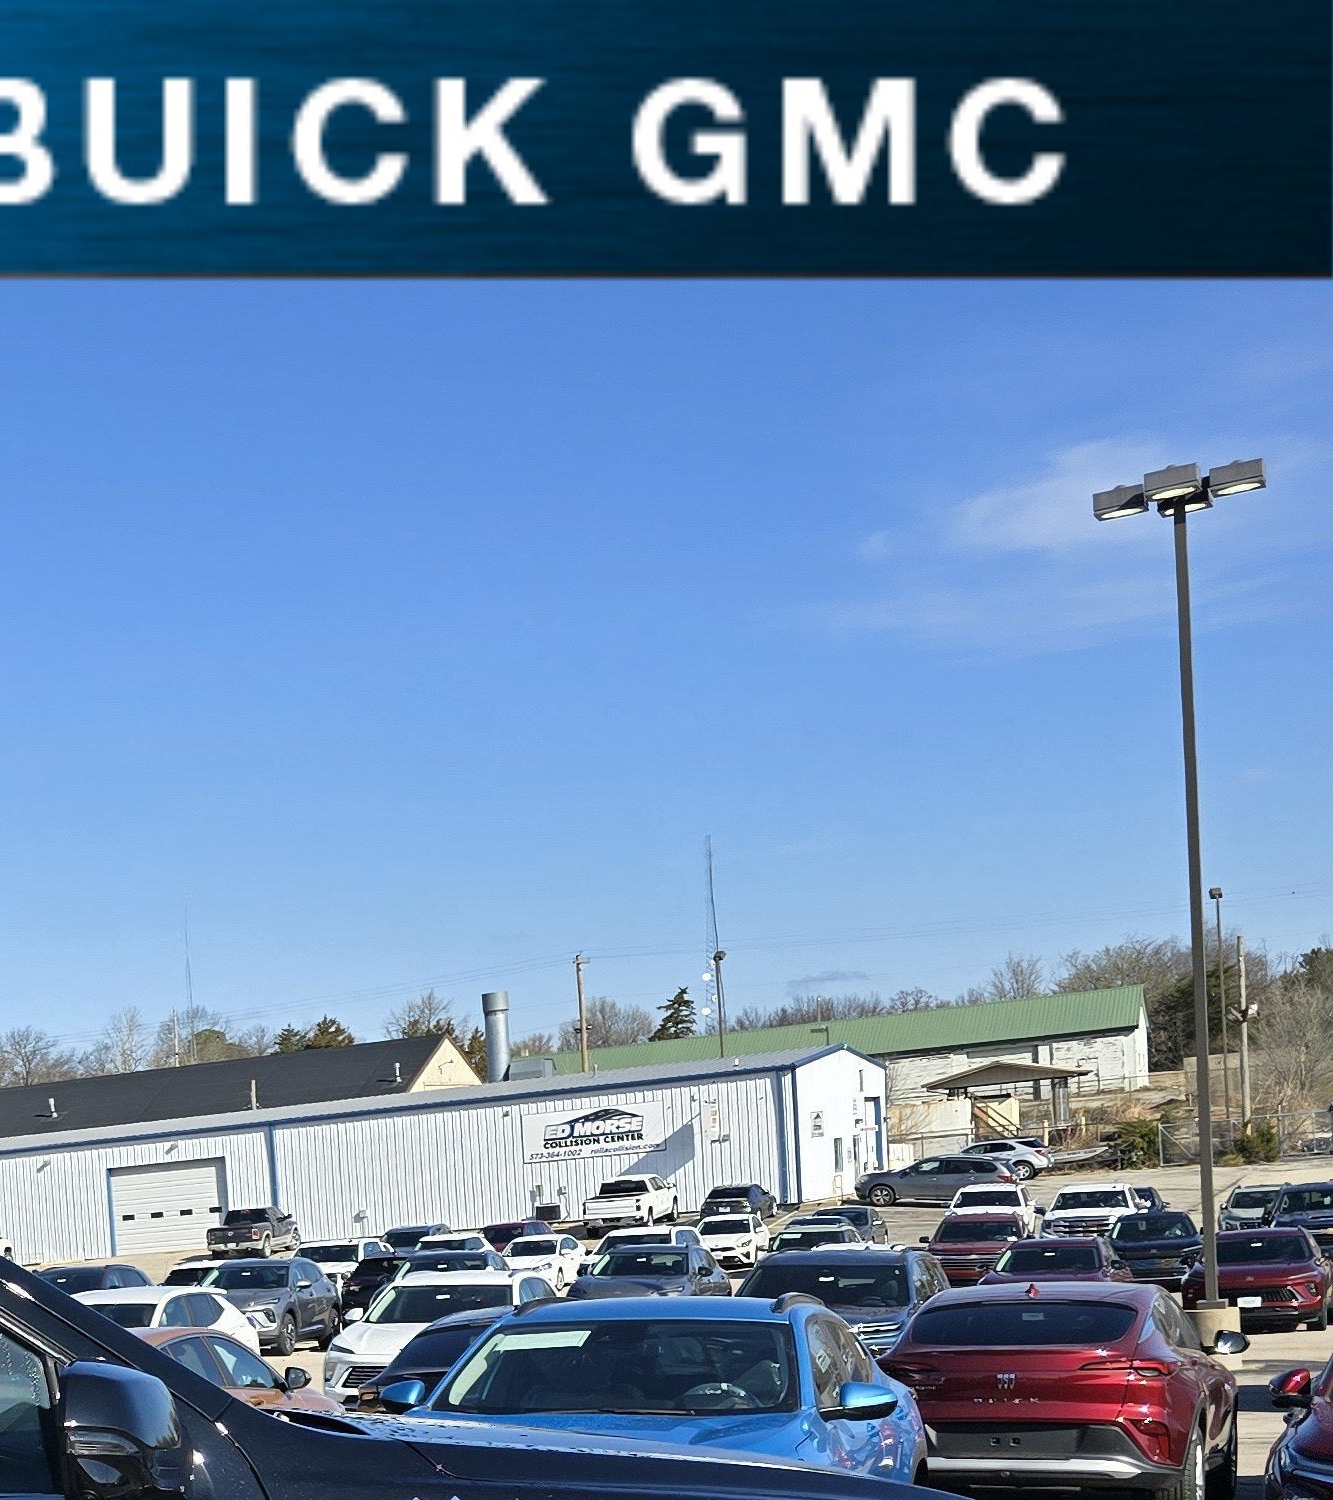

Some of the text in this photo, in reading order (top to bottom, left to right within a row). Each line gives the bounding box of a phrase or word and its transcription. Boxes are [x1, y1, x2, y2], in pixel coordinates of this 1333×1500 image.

[544, 1115, 644, 1141] ED MORSE
[543, 1133, 644, 1149] COLLISION CENTER
[529, 1149, 583, 1160] 573-364-1002
